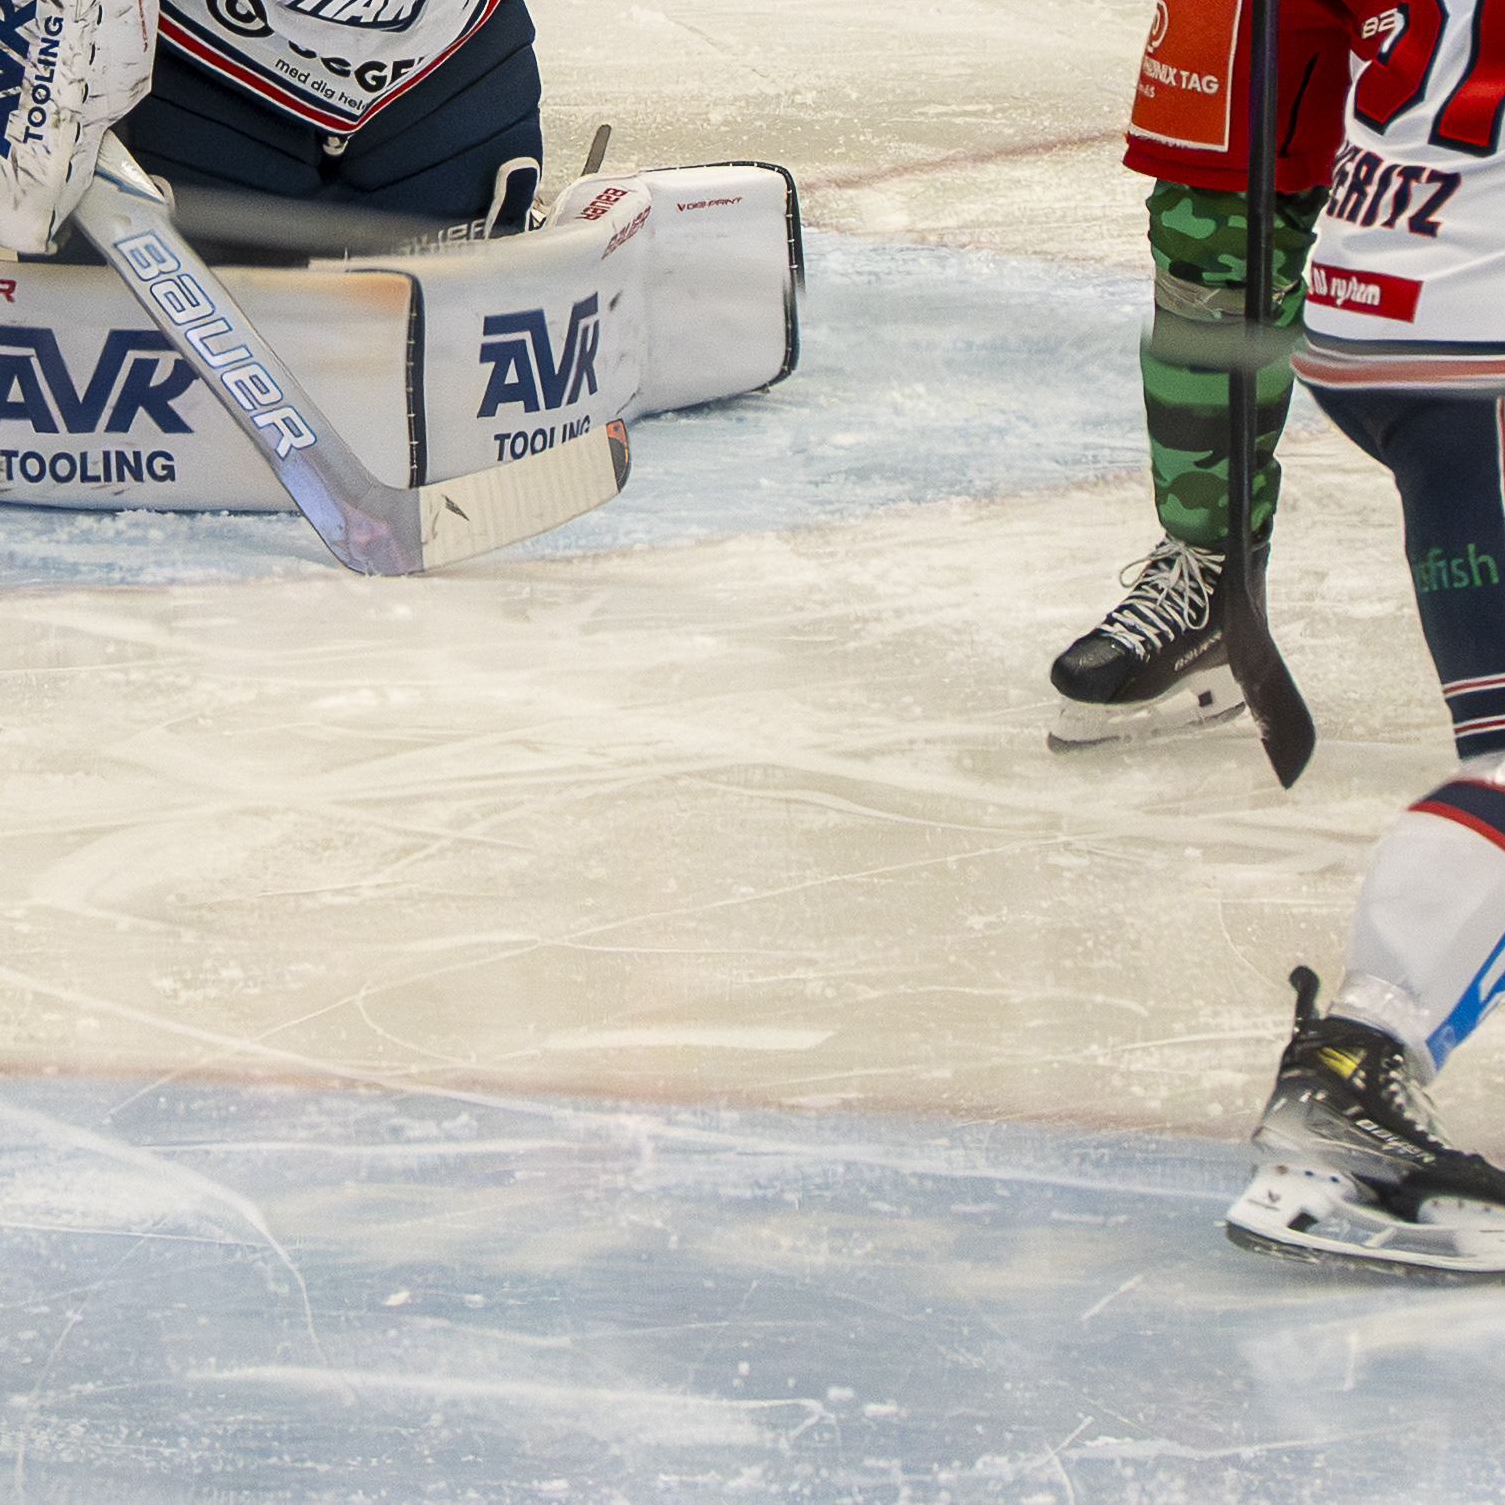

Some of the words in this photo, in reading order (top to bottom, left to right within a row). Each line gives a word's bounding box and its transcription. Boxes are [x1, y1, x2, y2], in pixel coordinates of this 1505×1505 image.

[23, 15, 64, 144] TOOLING
[274, 57, 311, 85] med
[310, 79, 336, 99] dig
[337, 91, 366, 111] hel
[1179, 69, 1220, 95] TAG
